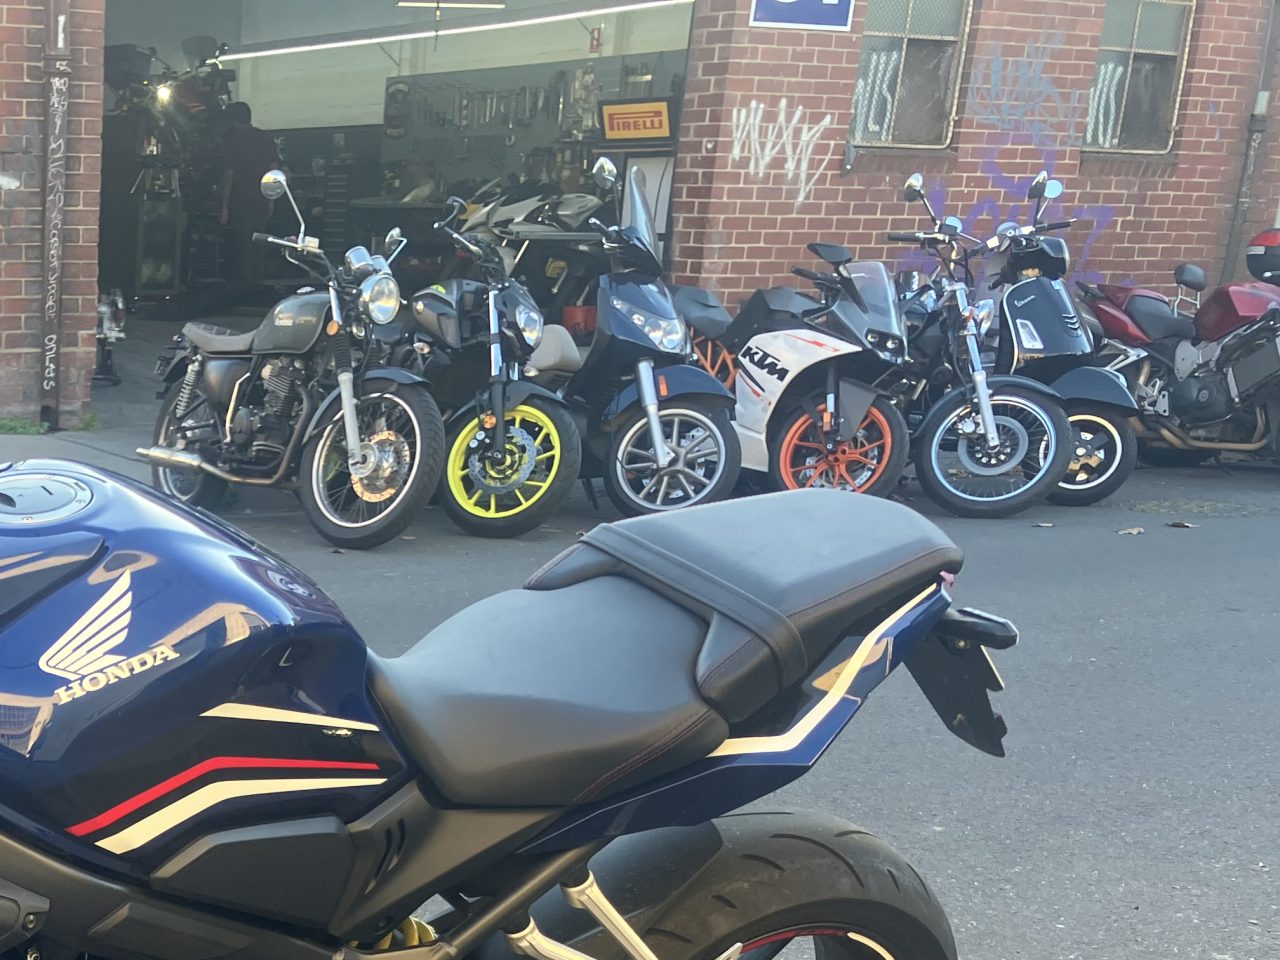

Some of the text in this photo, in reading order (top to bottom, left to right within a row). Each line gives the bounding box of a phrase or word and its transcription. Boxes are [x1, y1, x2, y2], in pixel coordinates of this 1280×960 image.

[607, 110, 663, 131] PIRELLI
[740, 345, 790, 382] KTM
[53, 644, 180, 706] HONDA
